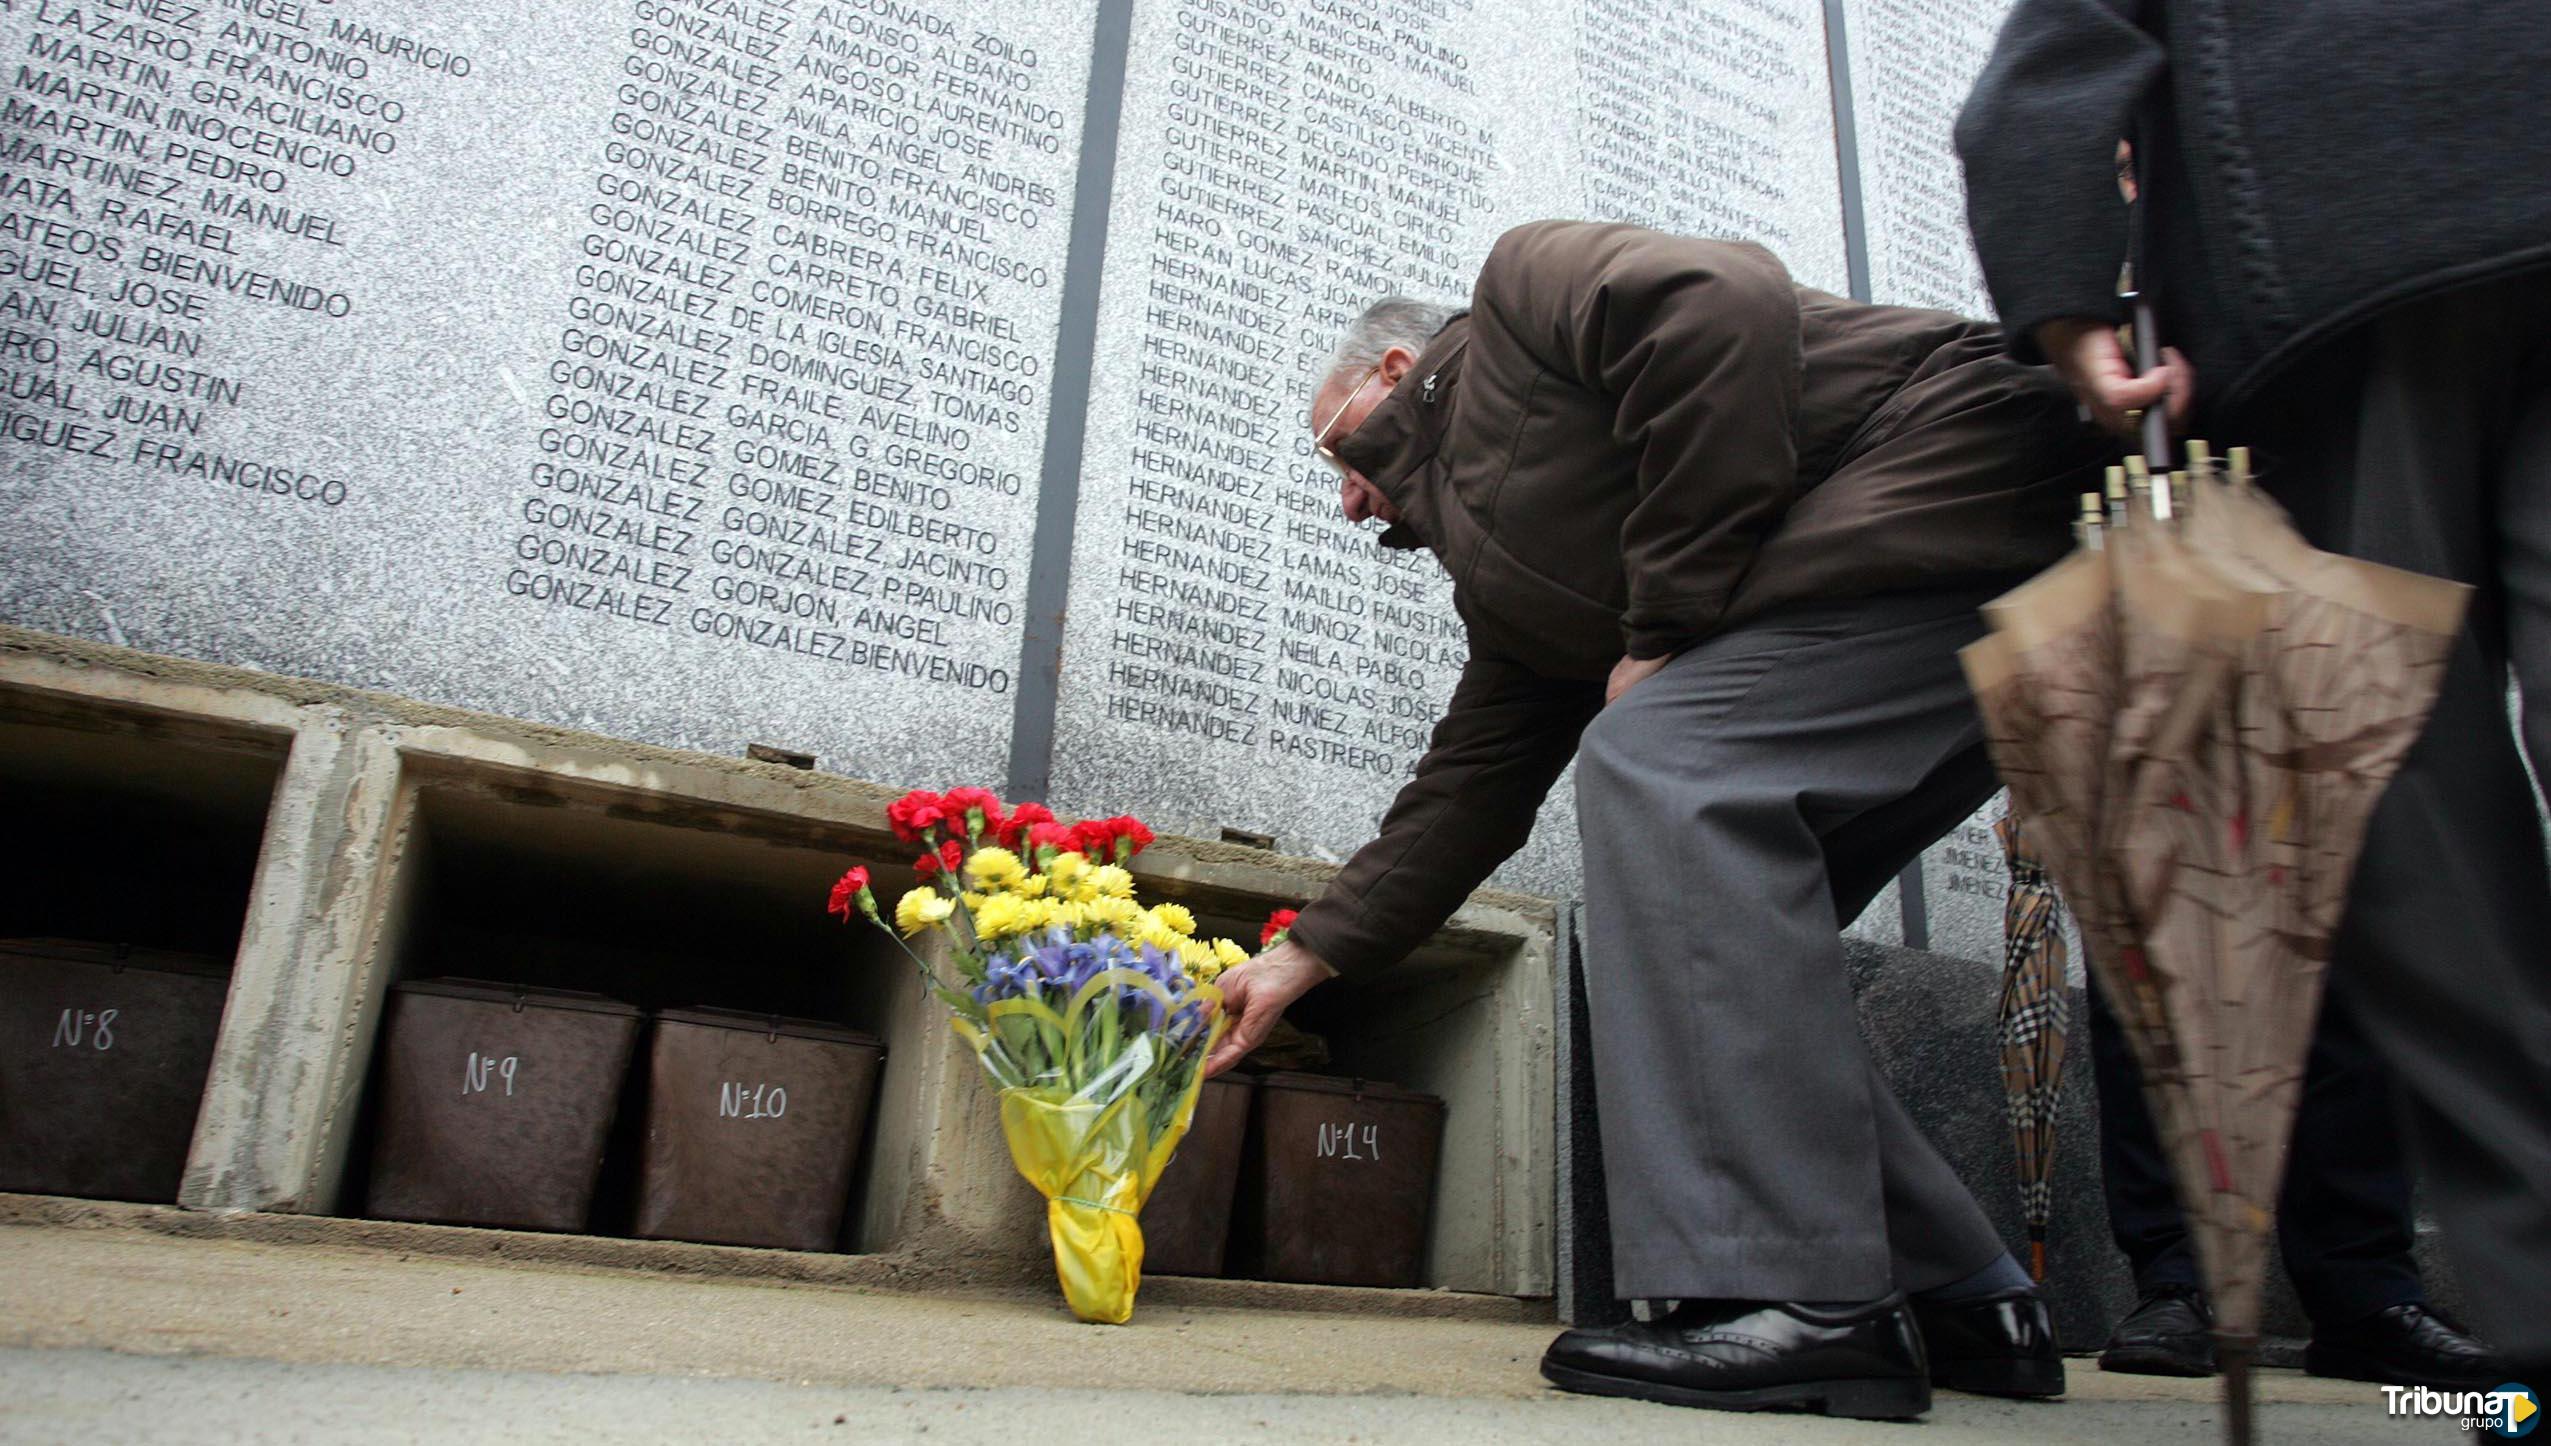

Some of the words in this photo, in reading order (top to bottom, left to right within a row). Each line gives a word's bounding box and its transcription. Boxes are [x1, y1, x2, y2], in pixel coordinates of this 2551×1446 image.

[219, 21, 368, 79] ANTONIO
[330, 19, 471, 77] MAURICIO
[635, 0, 781, 63] GONZALEZ
[815, 5, 920, 58] ALONSO,
[972, 31, 1037, 68] ZOILO
[1175, 32, 1291, 90] GUTIERREZ
[1177, 10, 1293, 67] GUTIERREZ
[28, 33, 173, 97] MARTIN,
[191, 81, 396, 154] GRACILIANO
[205, 49, 404, 123] FRANCISCO
[631, 28, 783, 92] GONZALEZ
[799, 83, 921, 139] APARICIO,
[929, 125, 993, 161] JOSE
[807, 30, 923, 86] AMADOR,
[933, 71, 1064, 130] FERNANDO
[1170, 79, 1286, 135] GUTIERREZ
[1172, 56, 1291, 113] GUTIERREZ
[1, 98, 150, 162] MARTIN,
[163, 142, 286, 193] PEDRO
[618, 83, 774, 147] GONZALEZ
[787, 135, 882, 184] BENITO,
[890, 167, 1039, 229] FRANCISCO
[624, 55, 768, 116] GONZALEZ
[783, 106, 856, 149] AVILA,
[868, 133, 949, 174] ANGEL
[962, 164, 1056, 207] ANDRES
[1165, 126, 1288, 185] GUTIERREZ
[1168, 103, 1289, 160] GUTIERREZ
[611, 112, 769, 175] GONZALEZ
[782, 163, 877, 212] BENITO,
[889, 195, 993, 244] MANUEL
[1160, 177, 1284, 233] GUTIERREZ
[1163, 151, 1286, 209] GUTIERREZ
[100, 199, 240, 255] RAFAEL
[201, 188, 345, 246] MANUEL
[597, 173, 757, 236] GONZALEZ
[773, 224, 910, 285] CABRERA,
[919, 266, 990, 305] FELIX
[605, 141, 755, 201] GONZALEZ
[906, 229, 1048, 288] FRANCISCO
[1157, 201, 1222, 237] HARO
[590, 203, 751, 266] GONZALEZ
[914, 295, 1022, 344] GABRIEL
[1154, 227, 1232, 268] HERAN
[109, 279, 209, 321] JOSE
[140, 246, 351, 318] BIENVENIDO
[583, 234, 736, 294] GONZALEZ
[751, 280, 887, 339] COMERON,
[894, 320, 1038, 377] FRANCISCO
[1149, 279, 1288, 340] HERNANDEZ
[1152, 252, 1289, 313] HERNANDEZ
[72, 309, 202, 358] JULIAN
[576, 264, 719, 321] GONZALEZ
[731, 306, 765, 334] DE
[775, 318, 807, 346] LA
[919, 357, 1035, 406] SANTIAGO
[1143, 333, 1276, 392] HERNANDEZ
[1146, 304, 1285, 365] HERNANDEZ
[79, 349, 243, 406] AGUSTIN
[562, 328, 729, 390] GONZALEZ
[741, 374, 848, 425] FRAILE,
[858, 405, 970, 452] AVELINO
[569, 296, 734, 359] GONZALEZ
[749, 343, 918, 411] DOMINGUEZ,
[931, 389, 1021, 434] TOMAS
[1141, 361, 1283, 422] HERNANDEZ
[103, 395, 203, 437] JUAN
[550, 360, 711, 419] GONZALEZ
[884, 443, 1021, 496] GREGORIO
[1138, 389, 1281, 448] HERNANDEZ
[133, 439, 347, 506] FRANCISCO
[546, 394, 717, 455] GONZALEZ
[734, 439, 843, 489] GOMEZ,
[853, 467, 951, 511] BENITO
[1131, 446, 1266, 502] HERNANDEZ
[1135, 417, 1275, 476] HERNANDEZ
[539, 428, 711, 489] GONZALEZ
[728, 472, 838, 523] GOMEZ,
[849, 500, 997, 555] EDILBERTO
[1129, 475, 1275, 534] HERNANDEZ
[524, 498, 694, 556] GONZALEZ
[711, 539, 873, 601] GONZALEZ,
[531, 462, 705, 523] GONZALEZ
[722, 506, 890, 568] GONZALEZ,
[895, 548, 1008, 591] JACINTO
[1126, 505, 1273, 563] HERNANDEZ
[1372, 571, 1427, 604] JOSE
[517, 534, 694, 594] GONZALEZ
[712, 575, 840, 629] GORJON,
[853, 607, 949, 647] ANGEL
[1123, 536, 1271, 592] HERNANDEZ
[507, 569, 674, 626] GONZALEZ
[1120, 567, 1268, 622] HERNANDEZ
[1113, 629, 1264, 684] HERNANDEZ
[1116, 598, 1266, 653] HERNANDEZ
[1356, 656, 1425, 690] PABLO
[1109, 661, 1260, 715] HERNANDEZ
[1107, 694, 1257, 747] HERNANDEZ
